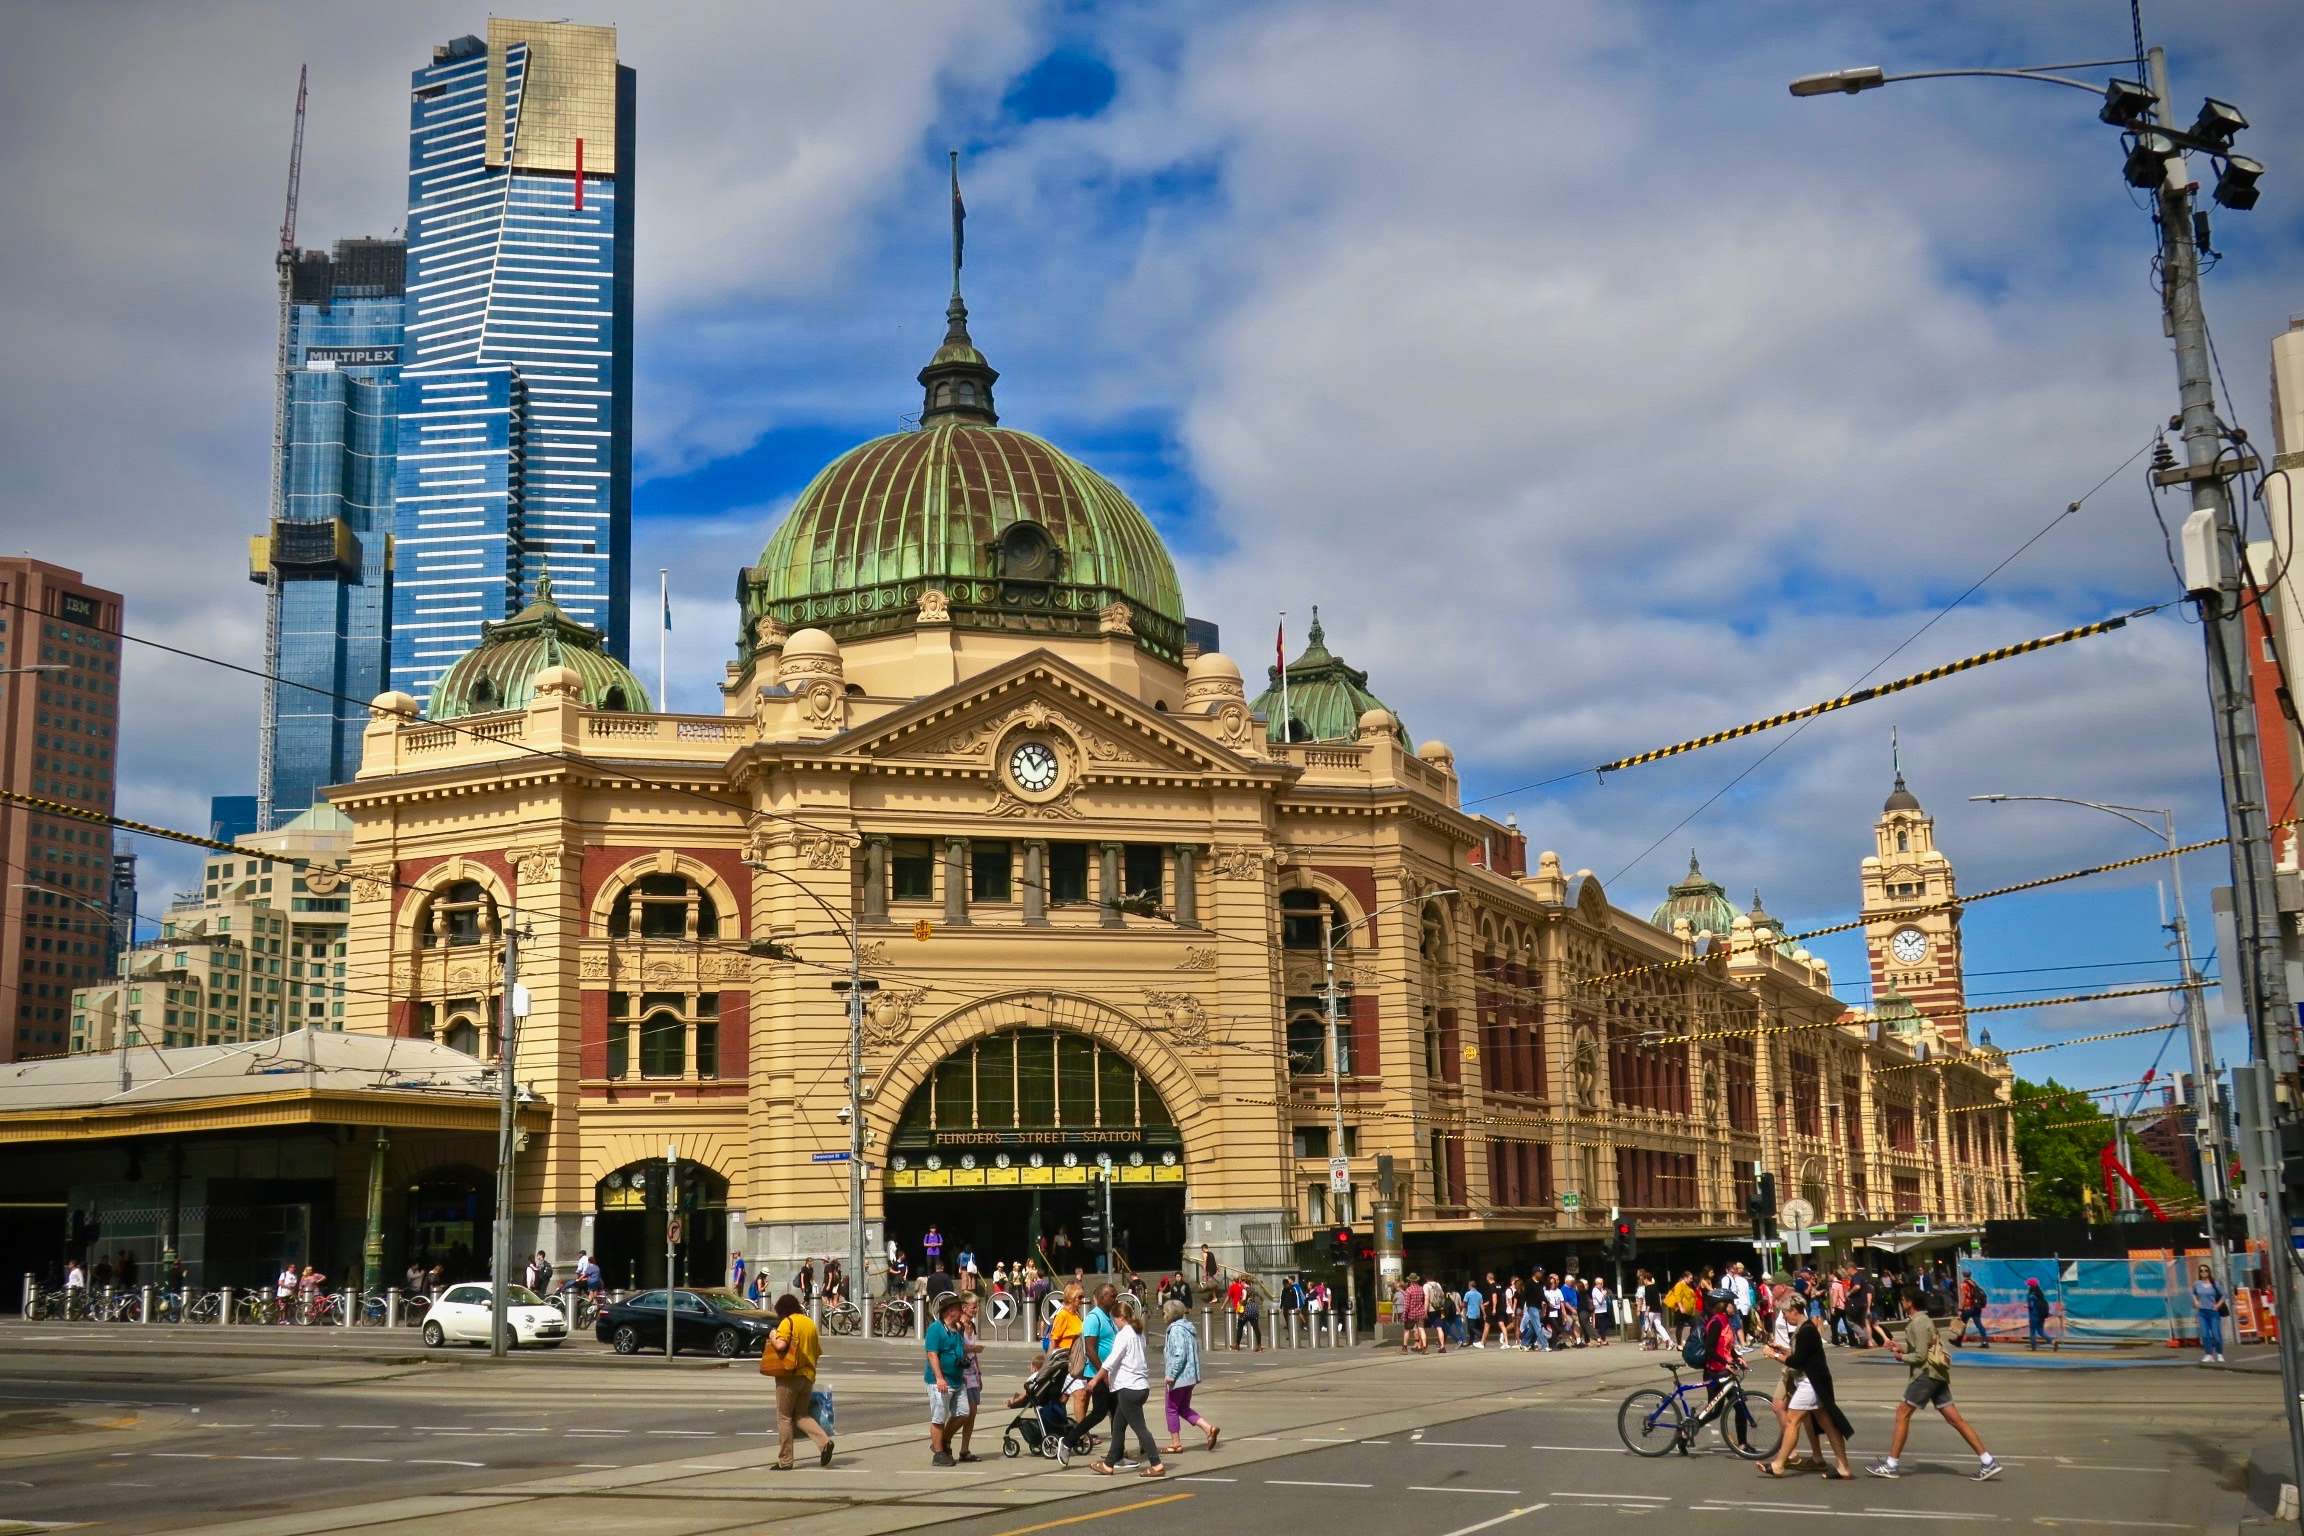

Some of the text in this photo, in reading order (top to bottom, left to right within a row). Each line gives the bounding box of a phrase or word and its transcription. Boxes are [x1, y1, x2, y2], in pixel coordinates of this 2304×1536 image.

[309, 350, 395, 362] MULTIPLEX
[66, 598, 90, 614] IBM
[916, 931, 929, 939] OFF
[935, 1131, 1141, 1145] FLINDERS STREET STATION
